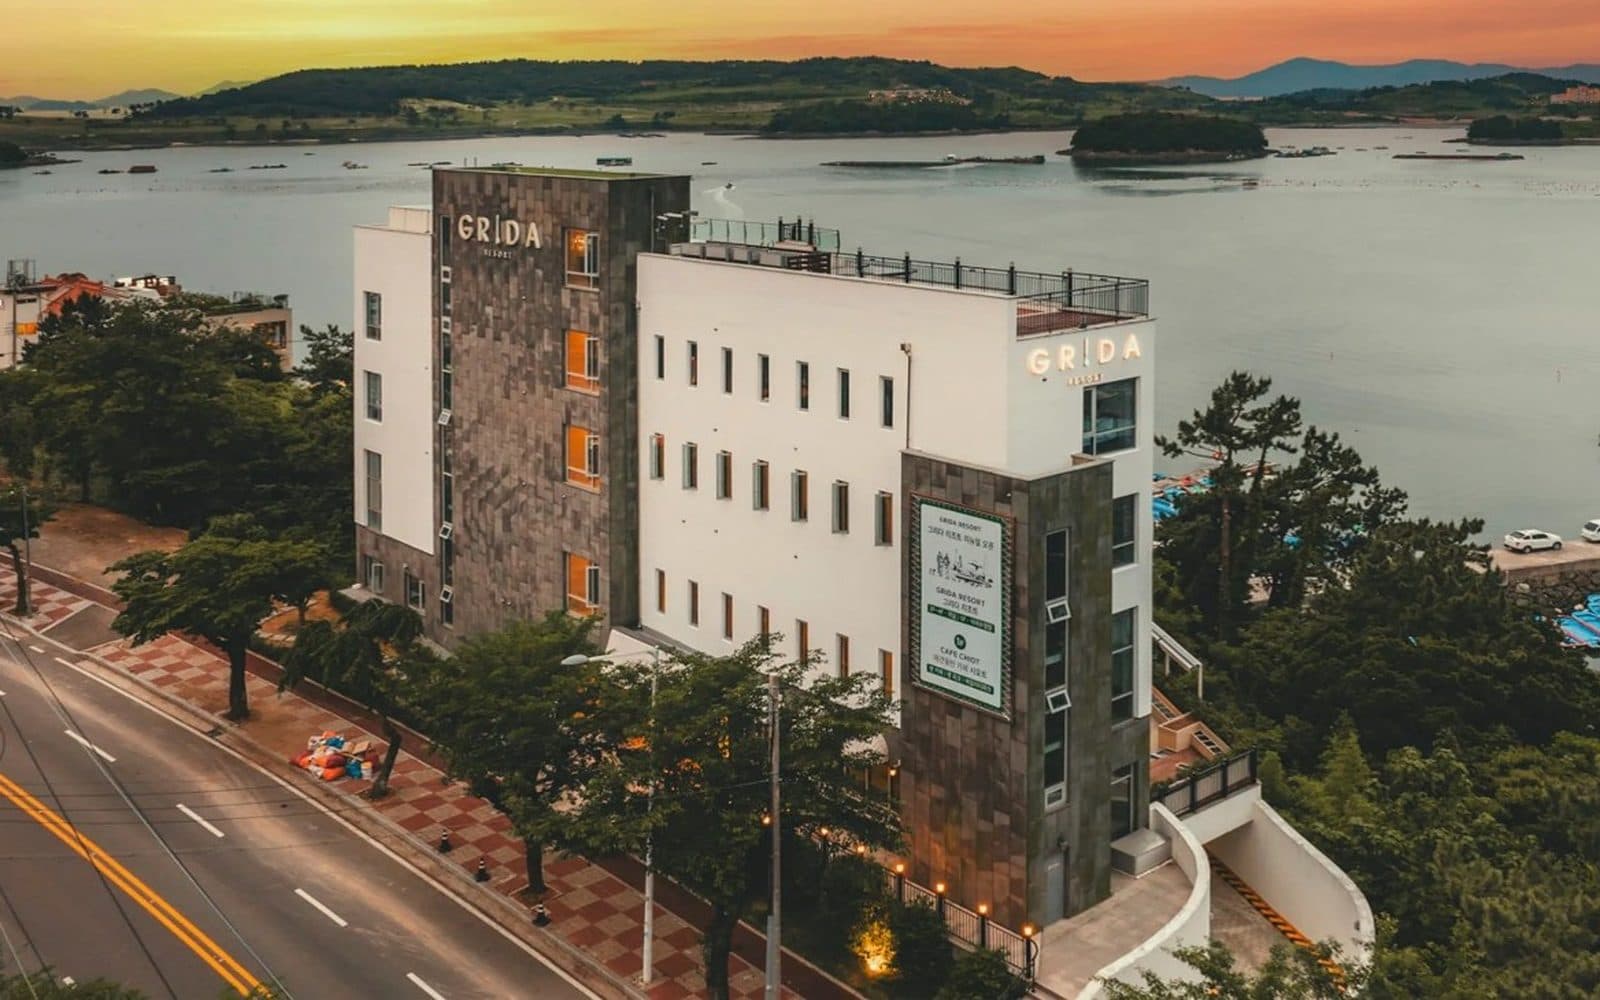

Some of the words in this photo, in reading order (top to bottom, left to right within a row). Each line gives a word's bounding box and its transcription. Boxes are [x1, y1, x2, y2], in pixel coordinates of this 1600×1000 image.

[458, 214, 541, 249] GRIDA
[1028, 334, 1140, 375] GRIDA
[936, 586, 957, 597] GRIDA
[958, 593, 985, 607] RESORT
